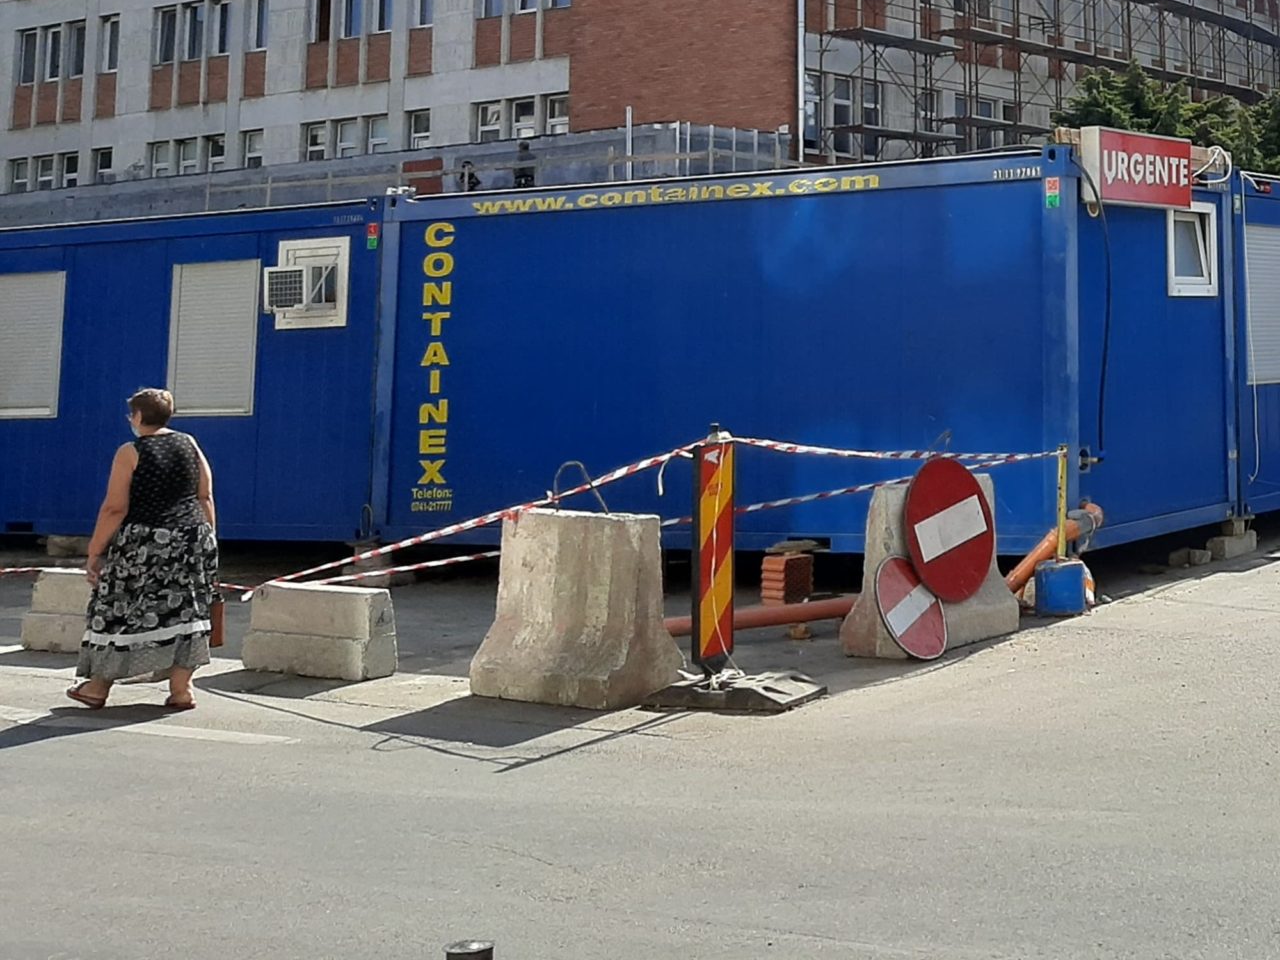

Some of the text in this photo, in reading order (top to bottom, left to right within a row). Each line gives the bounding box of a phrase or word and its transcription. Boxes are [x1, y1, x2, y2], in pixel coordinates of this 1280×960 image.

[1103, 149, 1189, 187] URGENTE
[472, 173, 880, 215] www.containex.com
[417, 222, 455, 484] CONTAINEX
[411, 487, 452, 499] Telefon:
